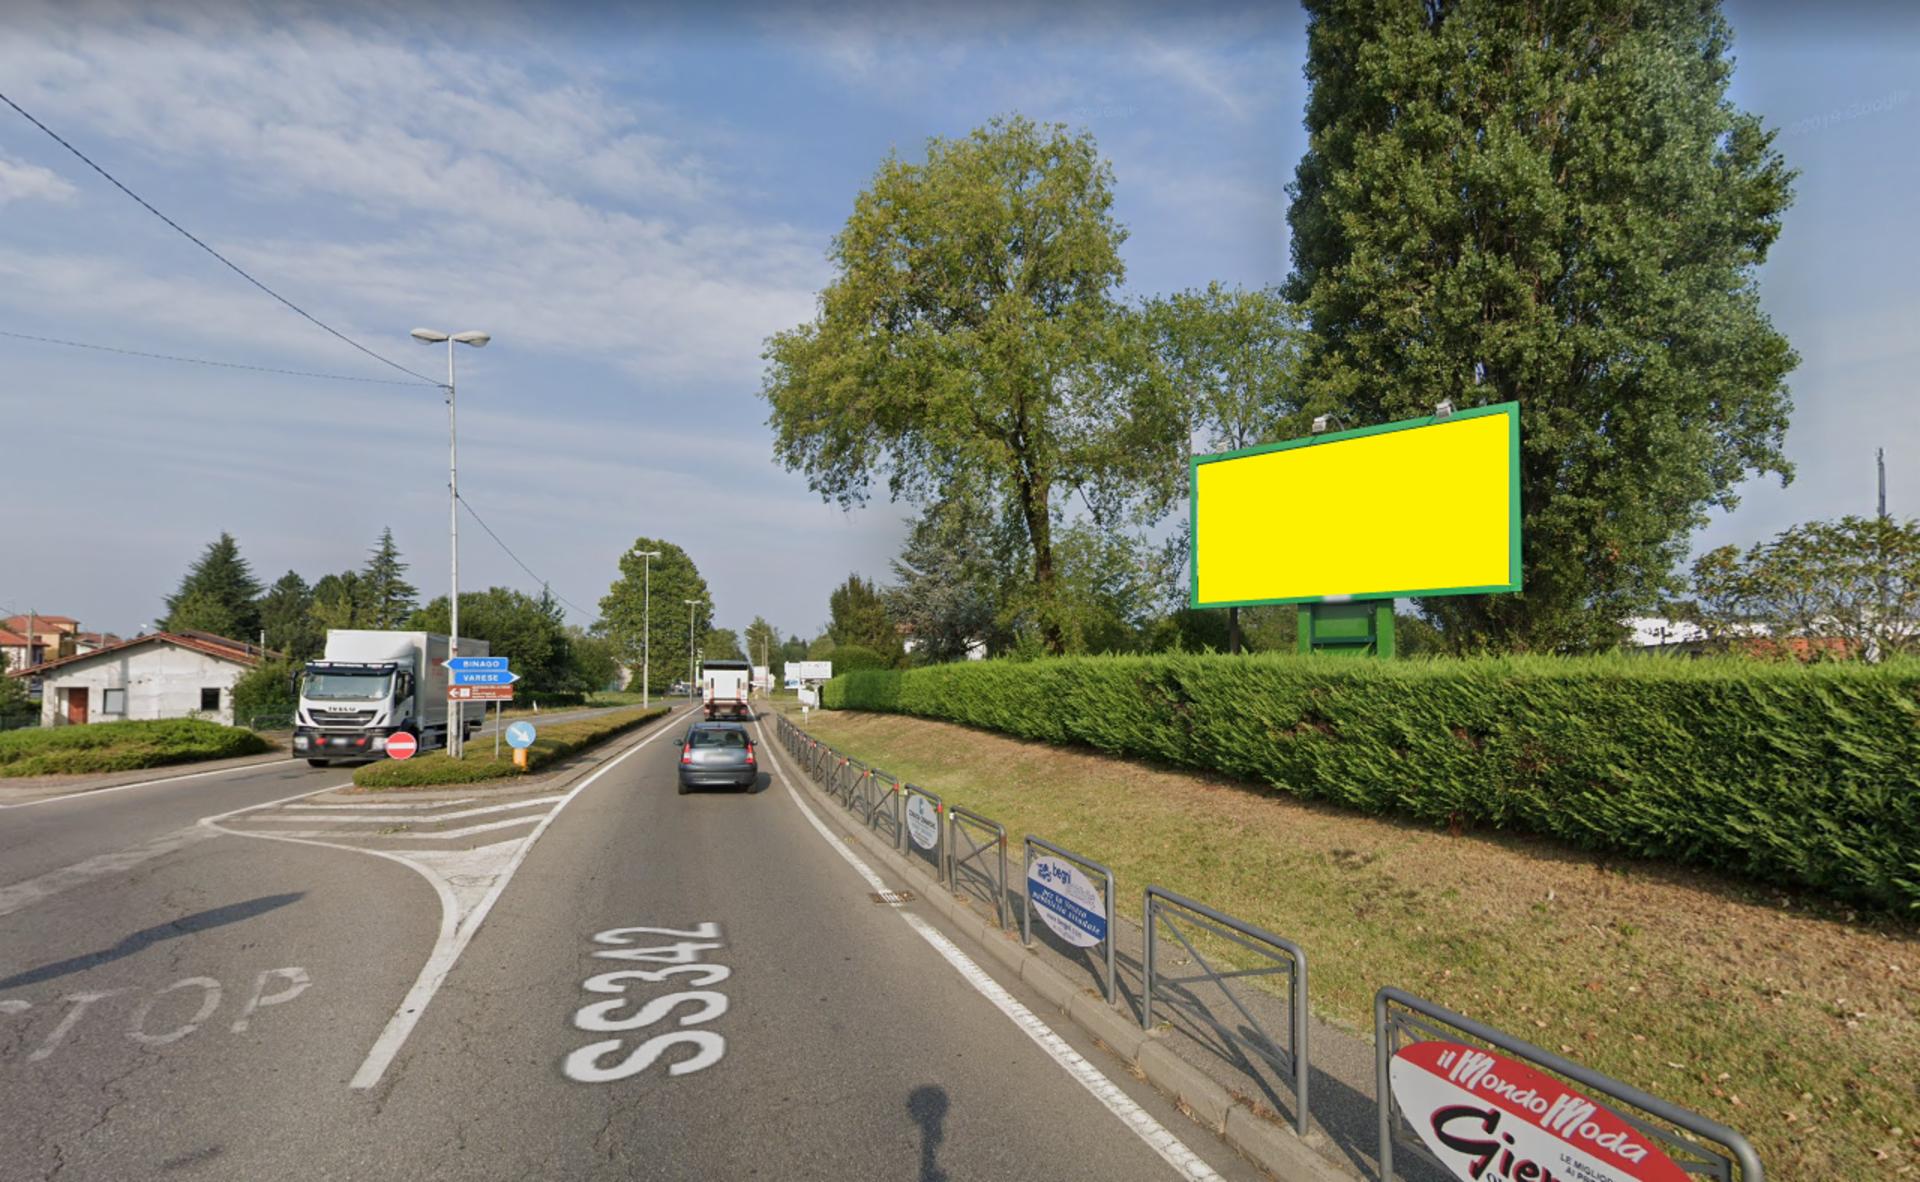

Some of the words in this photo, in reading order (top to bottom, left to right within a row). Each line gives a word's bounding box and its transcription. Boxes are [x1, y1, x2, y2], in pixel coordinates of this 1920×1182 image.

[462, 660, 500, 668] BINAGO
[462, 674, 499, 682] VARESE
[0, 967, 312, 1062] TOP
[564, 922, 731, 1082] SS342
[1436, 1050, 1456, 1069] il
[1448, 1049, 1549, 1115] Mondo
[1540, 1092, 1648, 1164] Moda
[1560, 1153, 1572, 1165] LE
